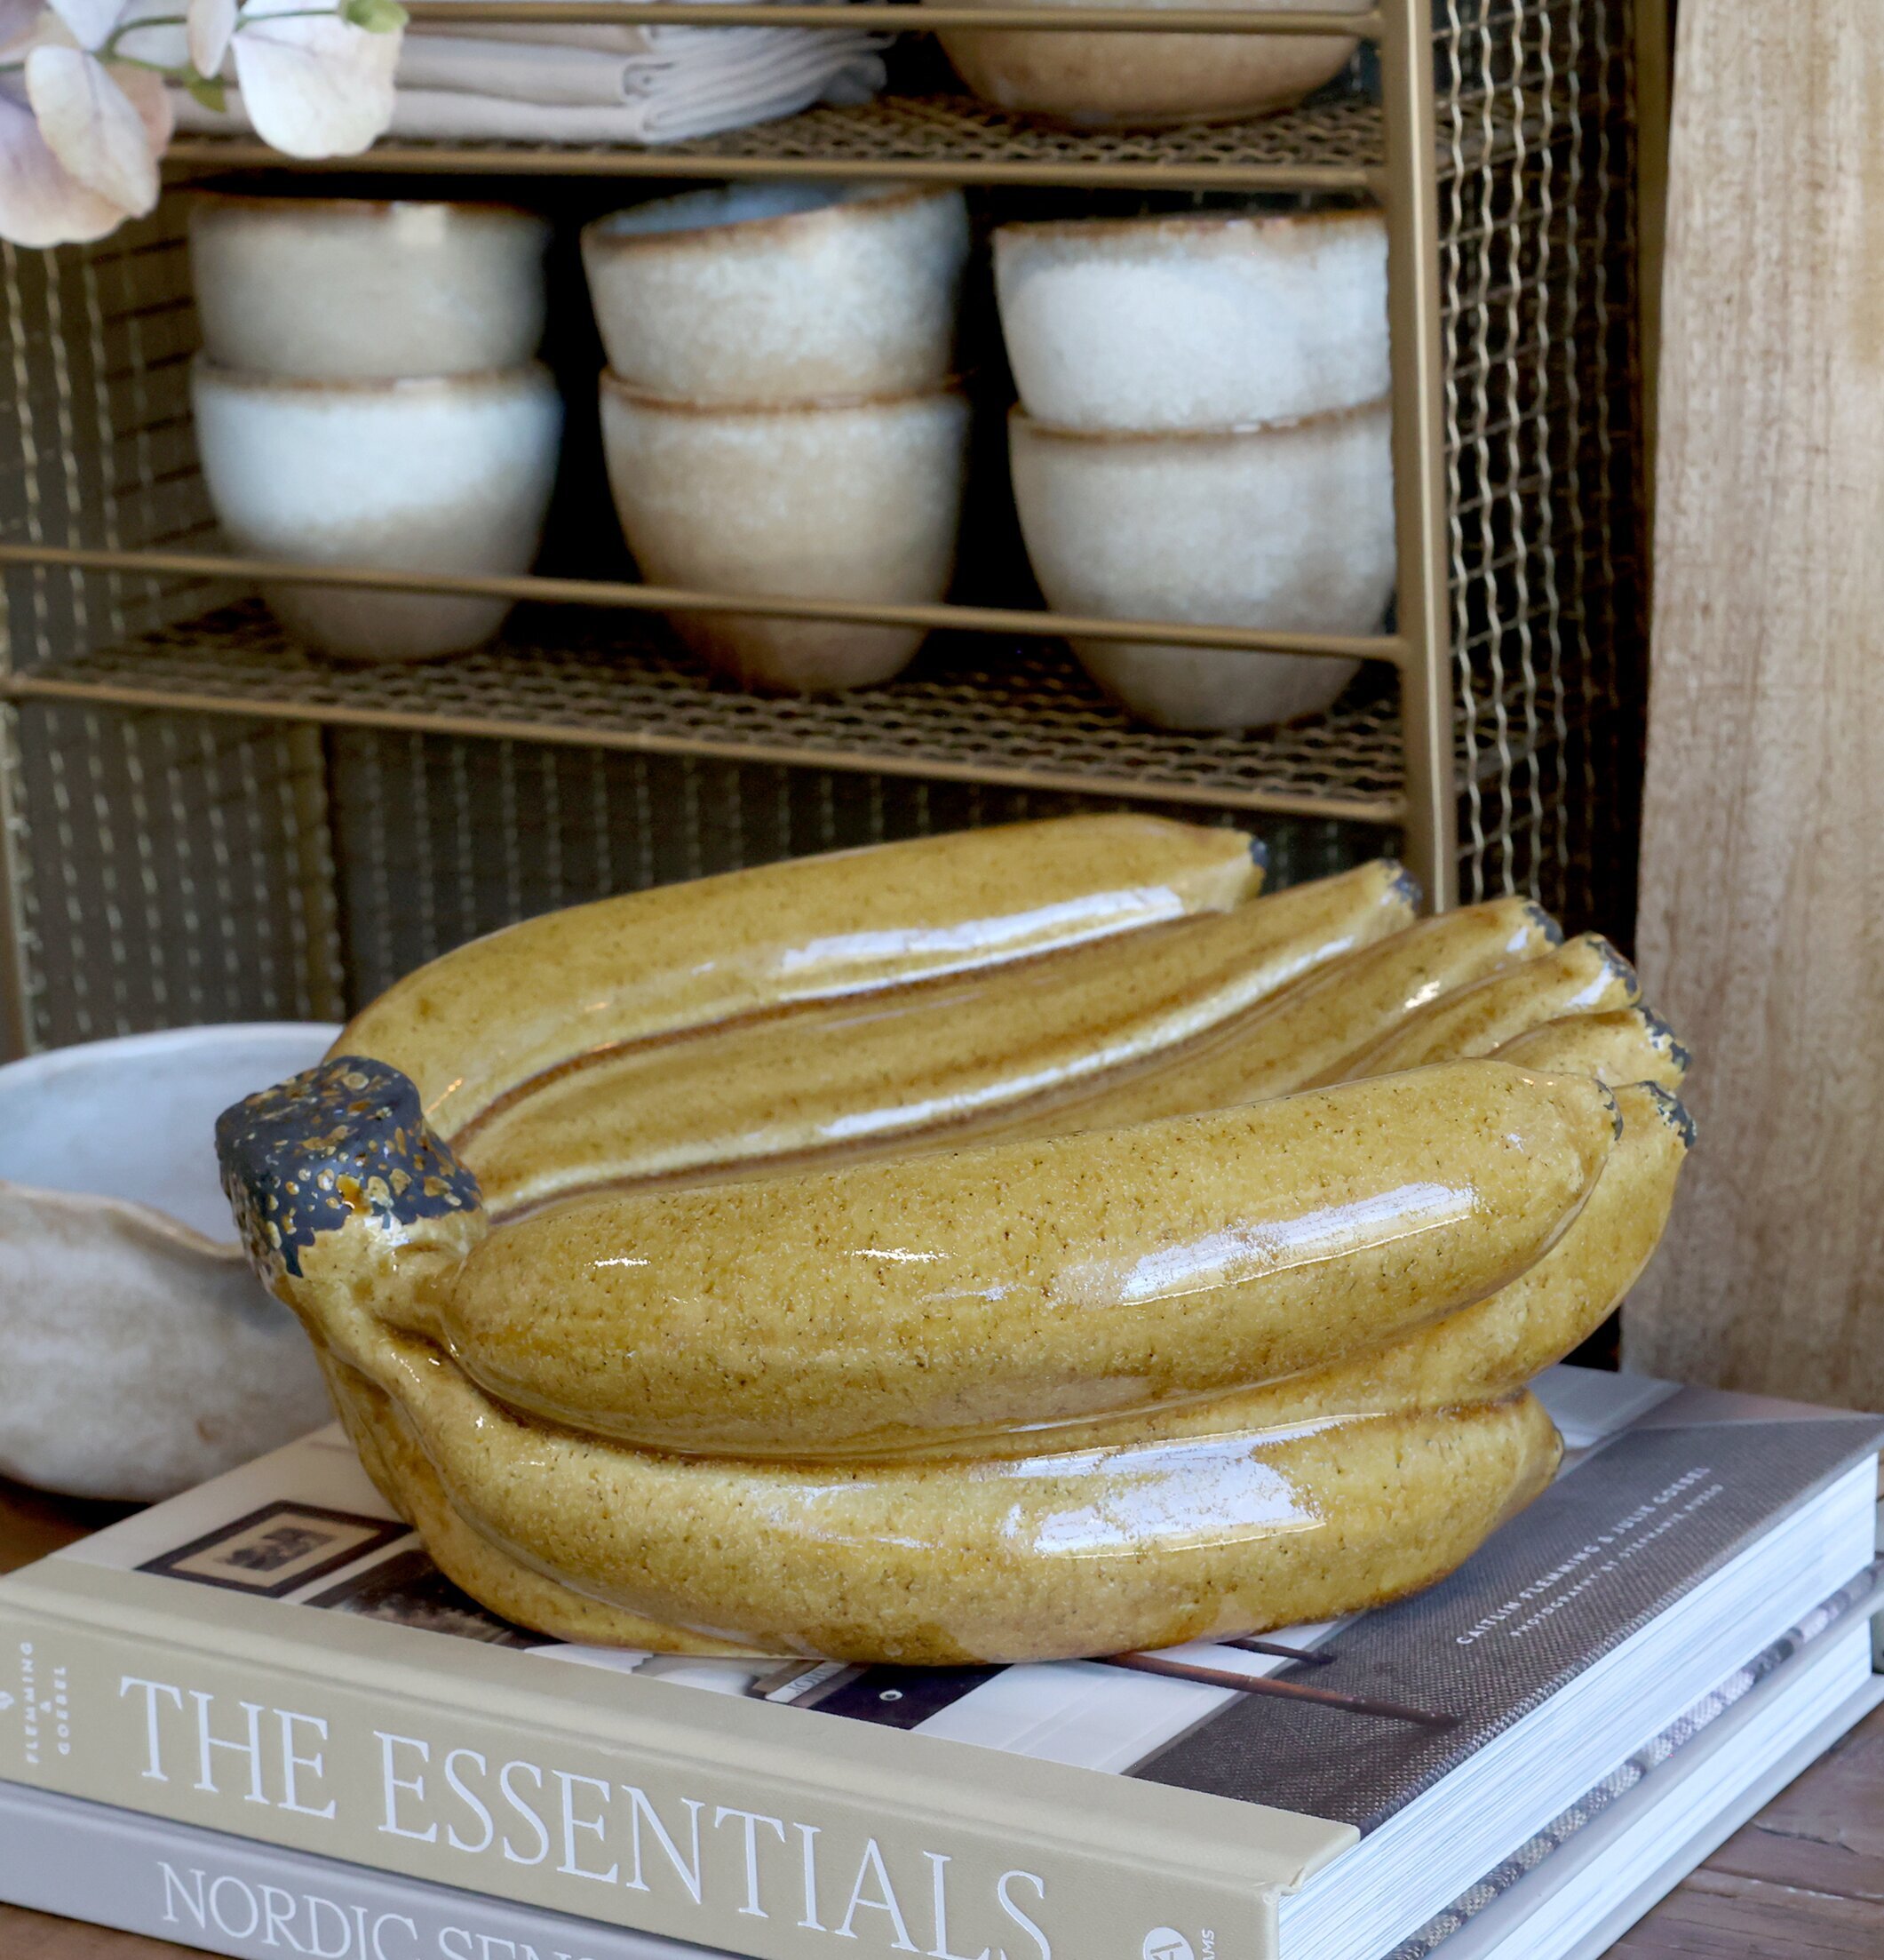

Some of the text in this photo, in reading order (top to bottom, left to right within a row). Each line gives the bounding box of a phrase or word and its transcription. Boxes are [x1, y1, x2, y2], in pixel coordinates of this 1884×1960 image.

[1456, 1601, 1522, 1644] CAITLIN
[1519, 1545, 1601, 1599] FLEMMING
[1611, 1505, 1657, 1535] JULIE
[1510, 1573, 1599, 1637] PHOTOGRAPHY
[20, 1641, 40, 1764] FLEMMING
[53, 1666, 71, 1756] GOEBEL
[120, 1676, 1051, 1960] THE ESSENTIALS
[157, 1861, 418, 1960] NORDIC
